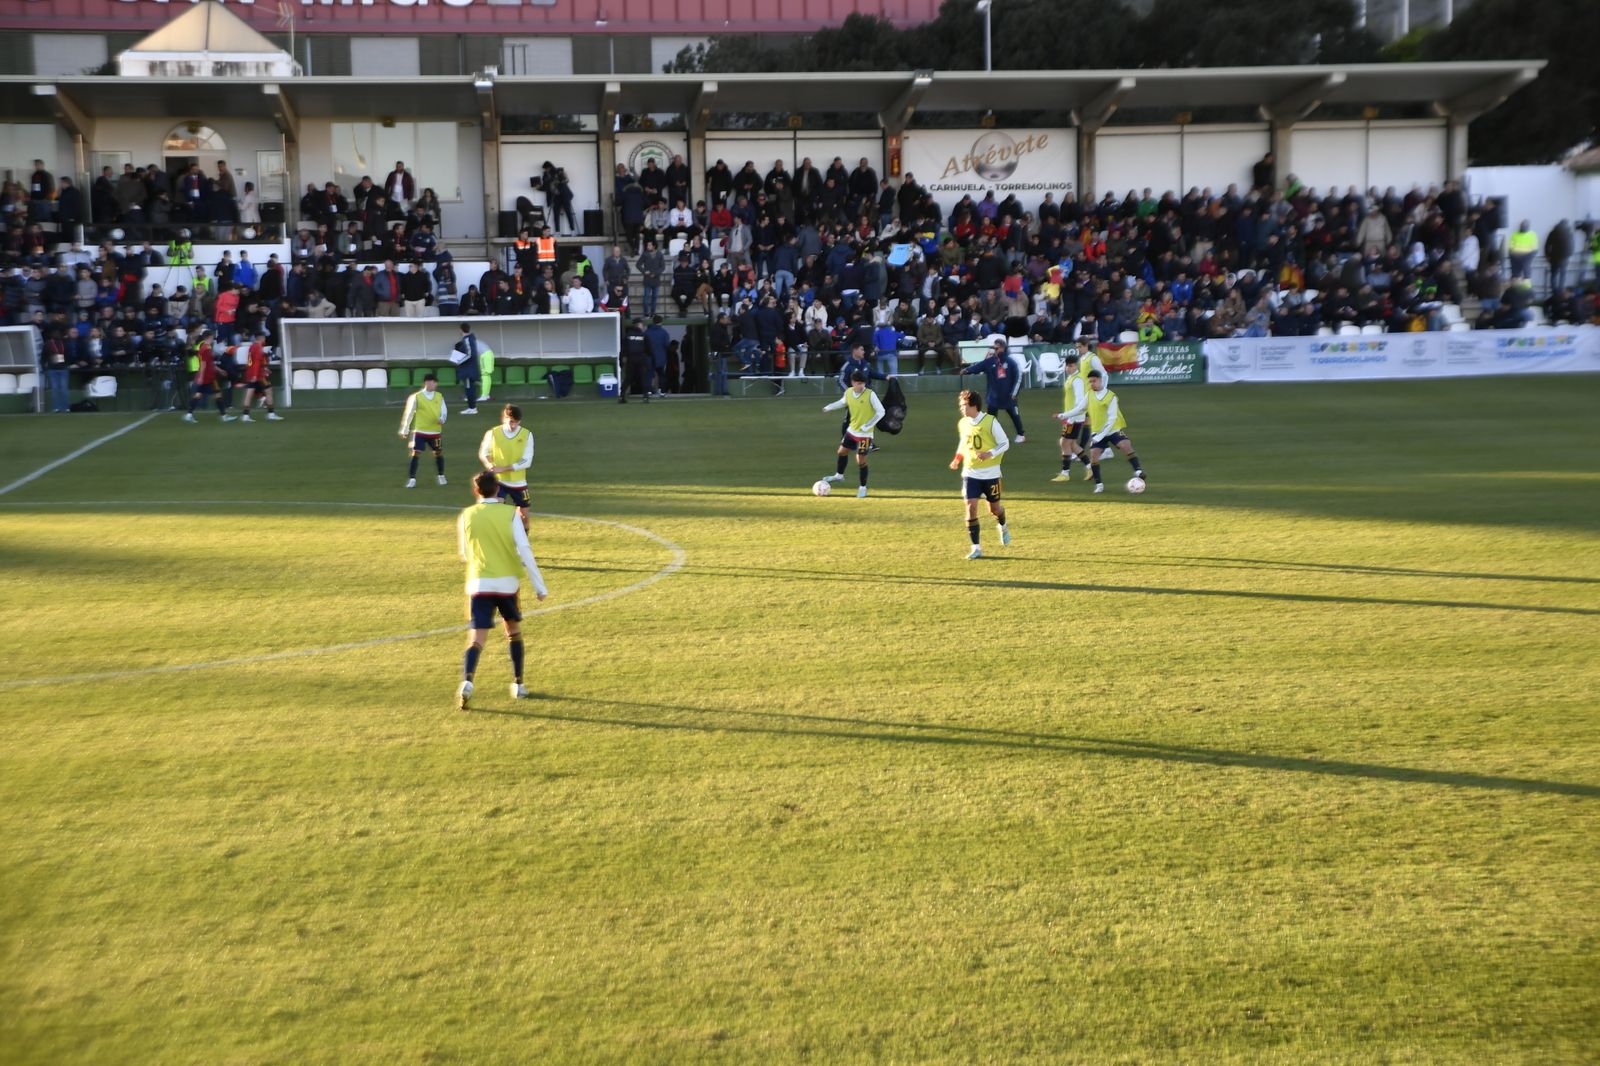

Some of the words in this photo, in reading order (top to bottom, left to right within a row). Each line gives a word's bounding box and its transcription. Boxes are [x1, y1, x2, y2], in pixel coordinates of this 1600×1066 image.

[939, 132, 1049, 180] Atrévete
[929, 183, 986, 192] CARIHUELA
[994, 182, 1073, 191] TORREMOLINOS
[990, 483, 999, 496] 21
